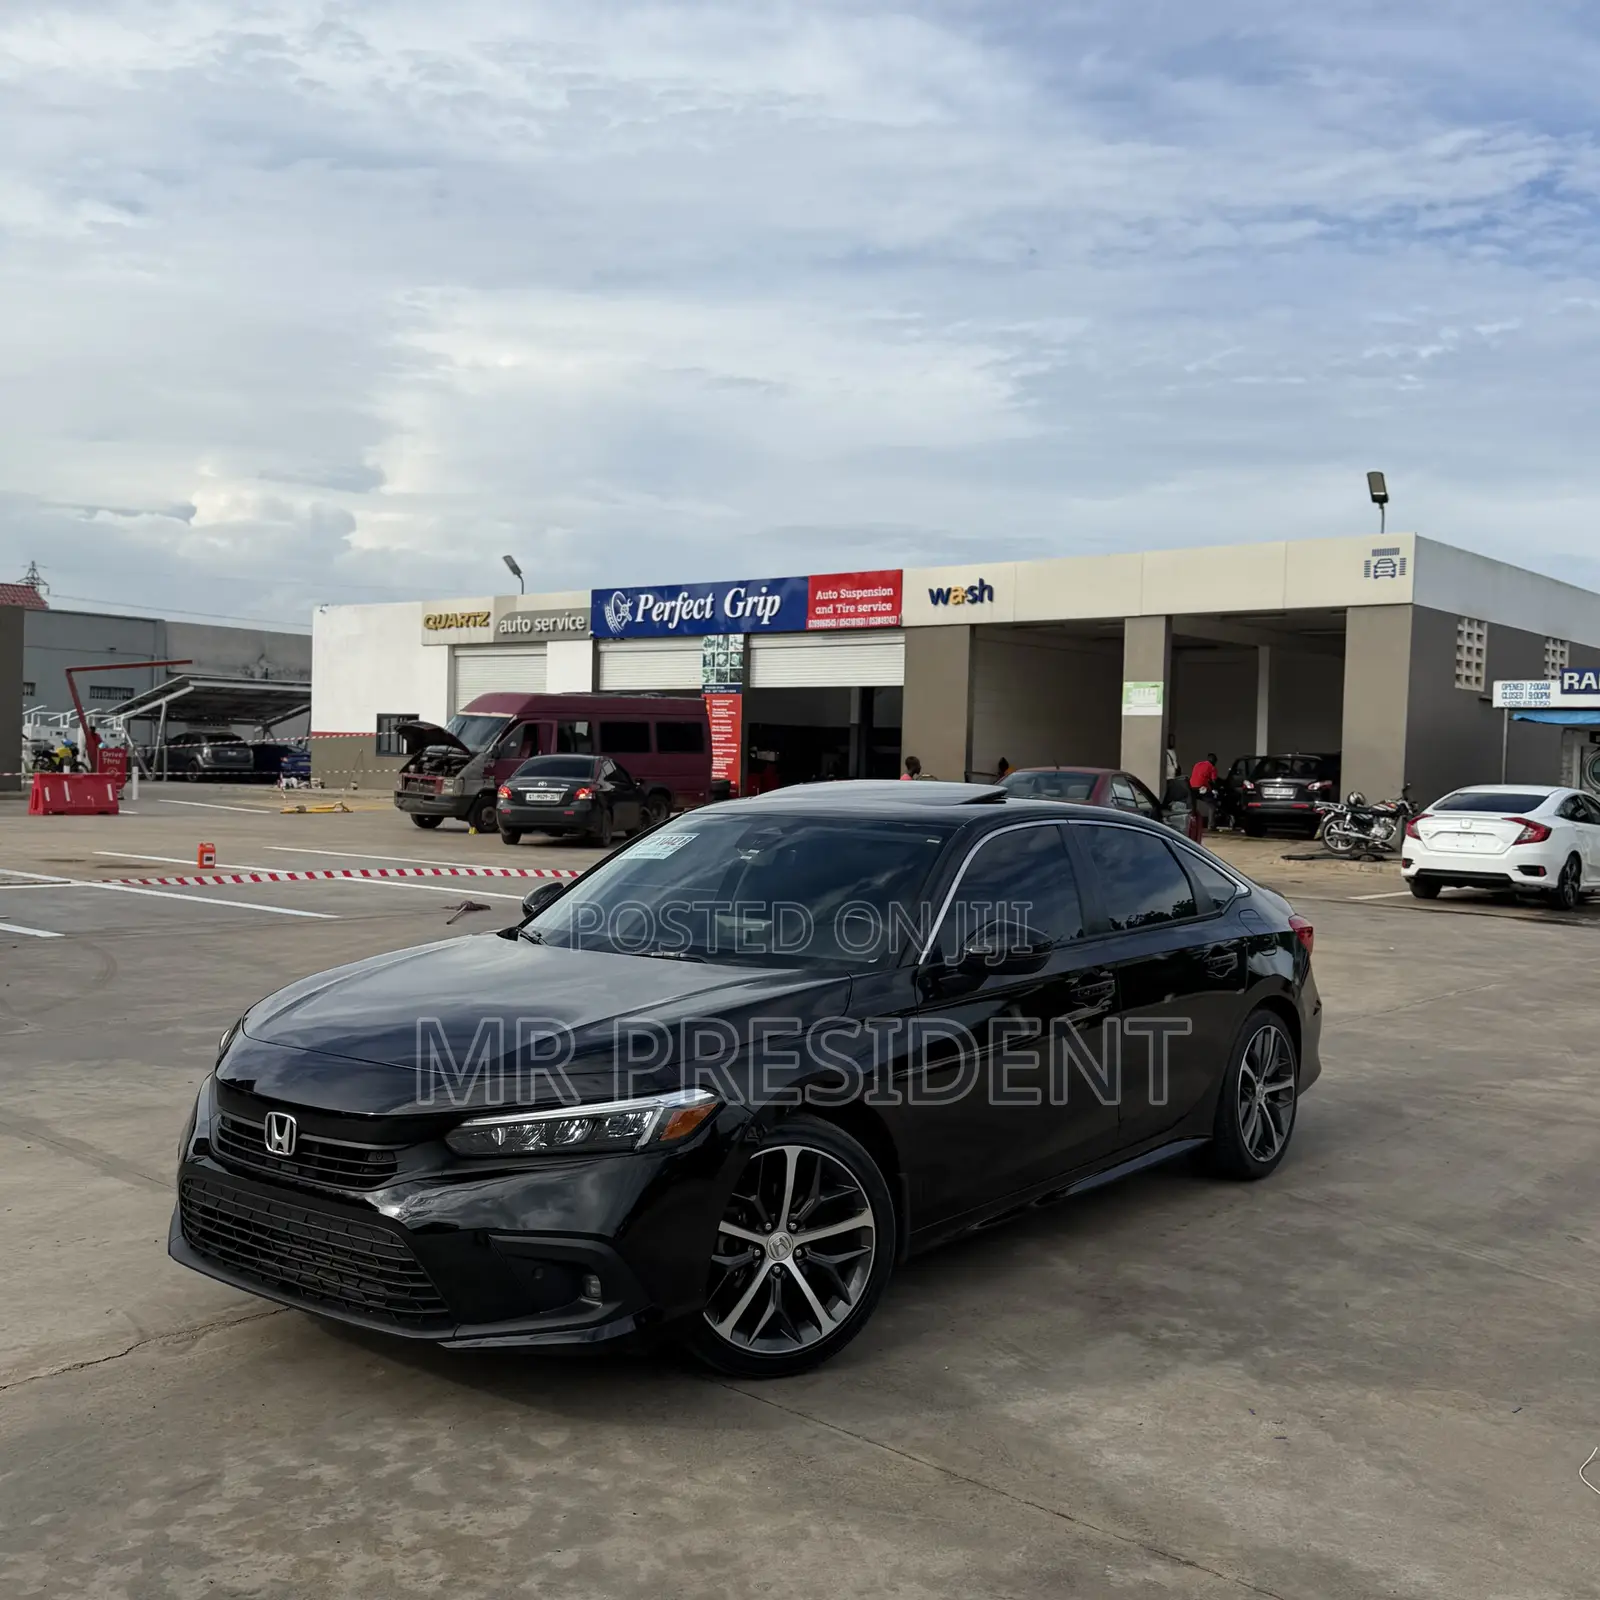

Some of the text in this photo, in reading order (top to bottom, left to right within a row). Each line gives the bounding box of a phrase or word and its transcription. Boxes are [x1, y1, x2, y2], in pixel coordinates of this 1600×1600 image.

[816, 586, 894, 600] Auto Suspension
[928, 577, 994, 606] wash
[634, 586, 781, 629] Perfect Grip
[815, 601, 893, 615] and Tire service
[424, 611, 491, 631] QUARTZ
[500, 612, 586, 633] auto service
[1501, 682, 1551, 691] OPENED 7:00AM
[1563, 672, 1600, 690] RA
[1501, 692, 1524, 700] CLOSED
